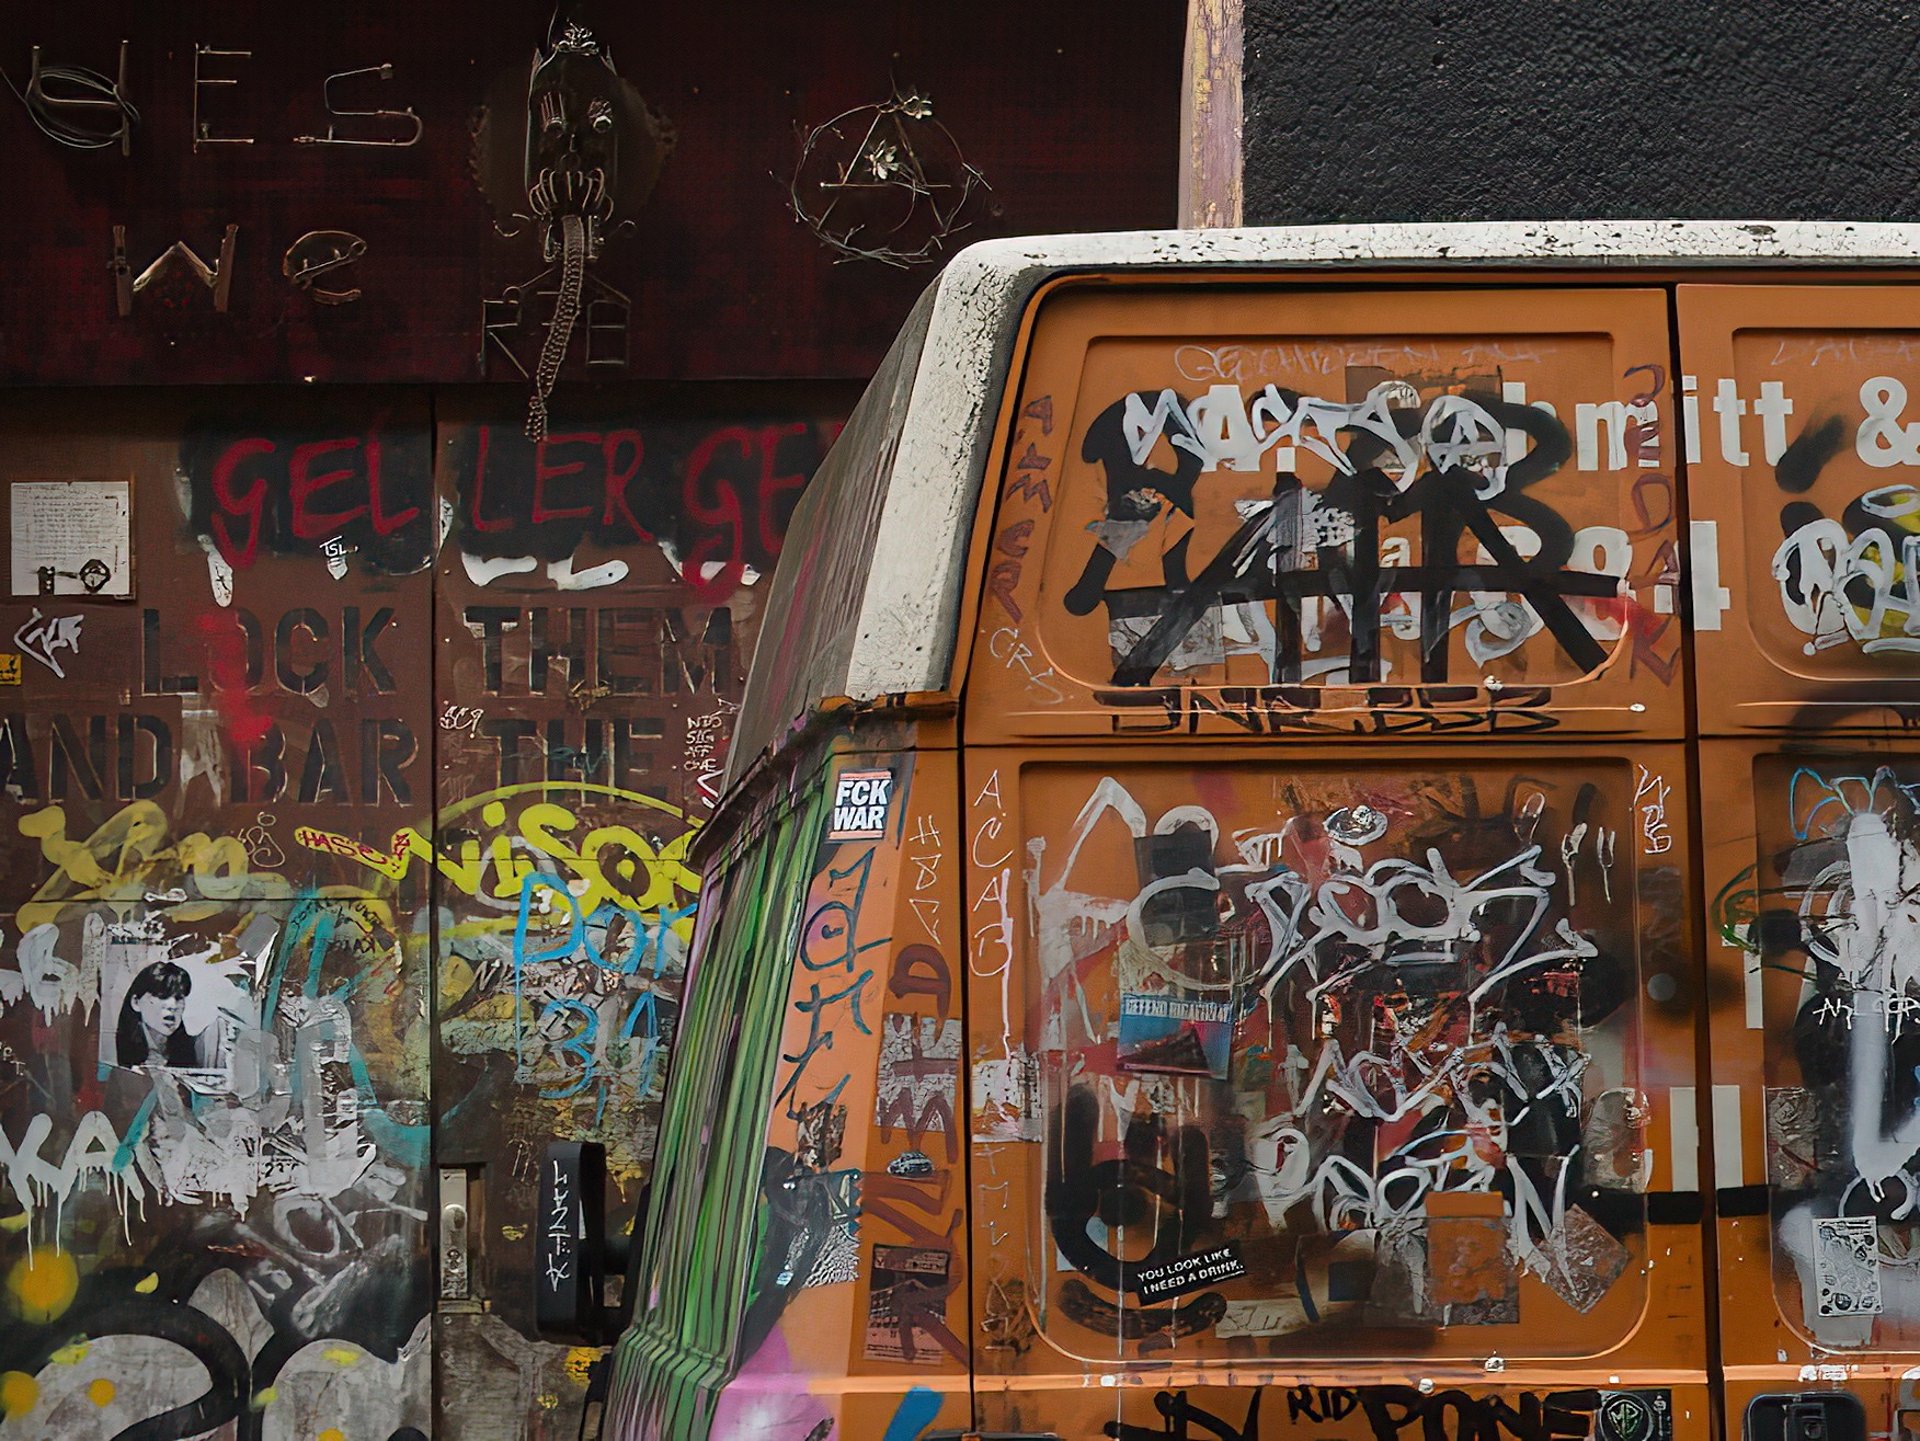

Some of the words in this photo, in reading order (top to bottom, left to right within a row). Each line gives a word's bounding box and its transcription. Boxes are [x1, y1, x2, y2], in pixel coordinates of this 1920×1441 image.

[140, 607, 399, 697] LOCK
[463, 605, 736, 697] THEM
[230, 713, 416, 807] BAR
[835, 779, 891, 806] FCK
[833, 806, 885, 831] WAR
[1138, 1267, 1164, 1282] YOU
[1166, 1257, 1202, 1275] LOOK
[1204, 1248, 1232, 1264] LIKE
[1143, 1285, 1149, 1295] I
[1150, 1275, 1186, 1293] NEED
[1188, 1272, 1197, 1283] A
